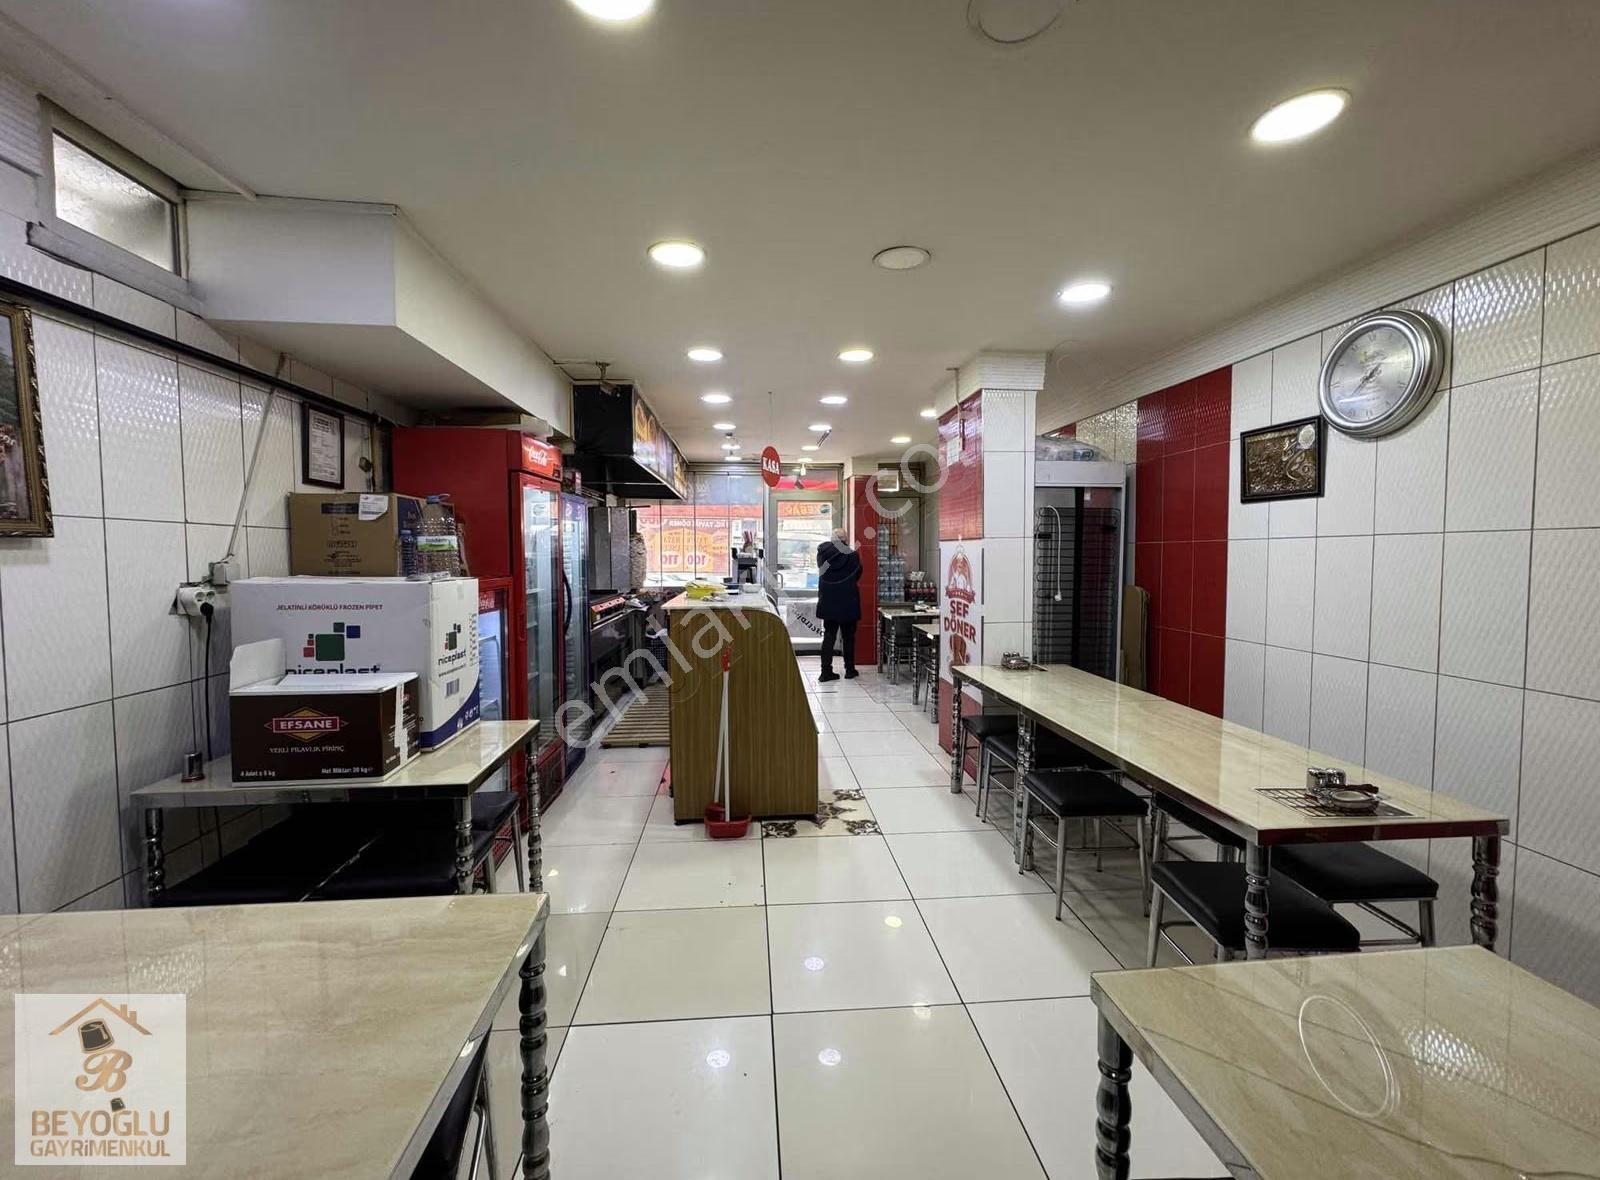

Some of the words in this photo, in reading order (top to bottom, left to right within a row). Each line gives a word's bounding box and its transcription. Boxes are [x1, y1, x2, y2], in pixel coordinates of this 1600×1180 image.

[762, 456, 780, 475] KASA
[944, 614, 976, 644] DÖNER
[438, 648, 466, 666] niceplast
[280, 719, 333, 730] EFSANE
